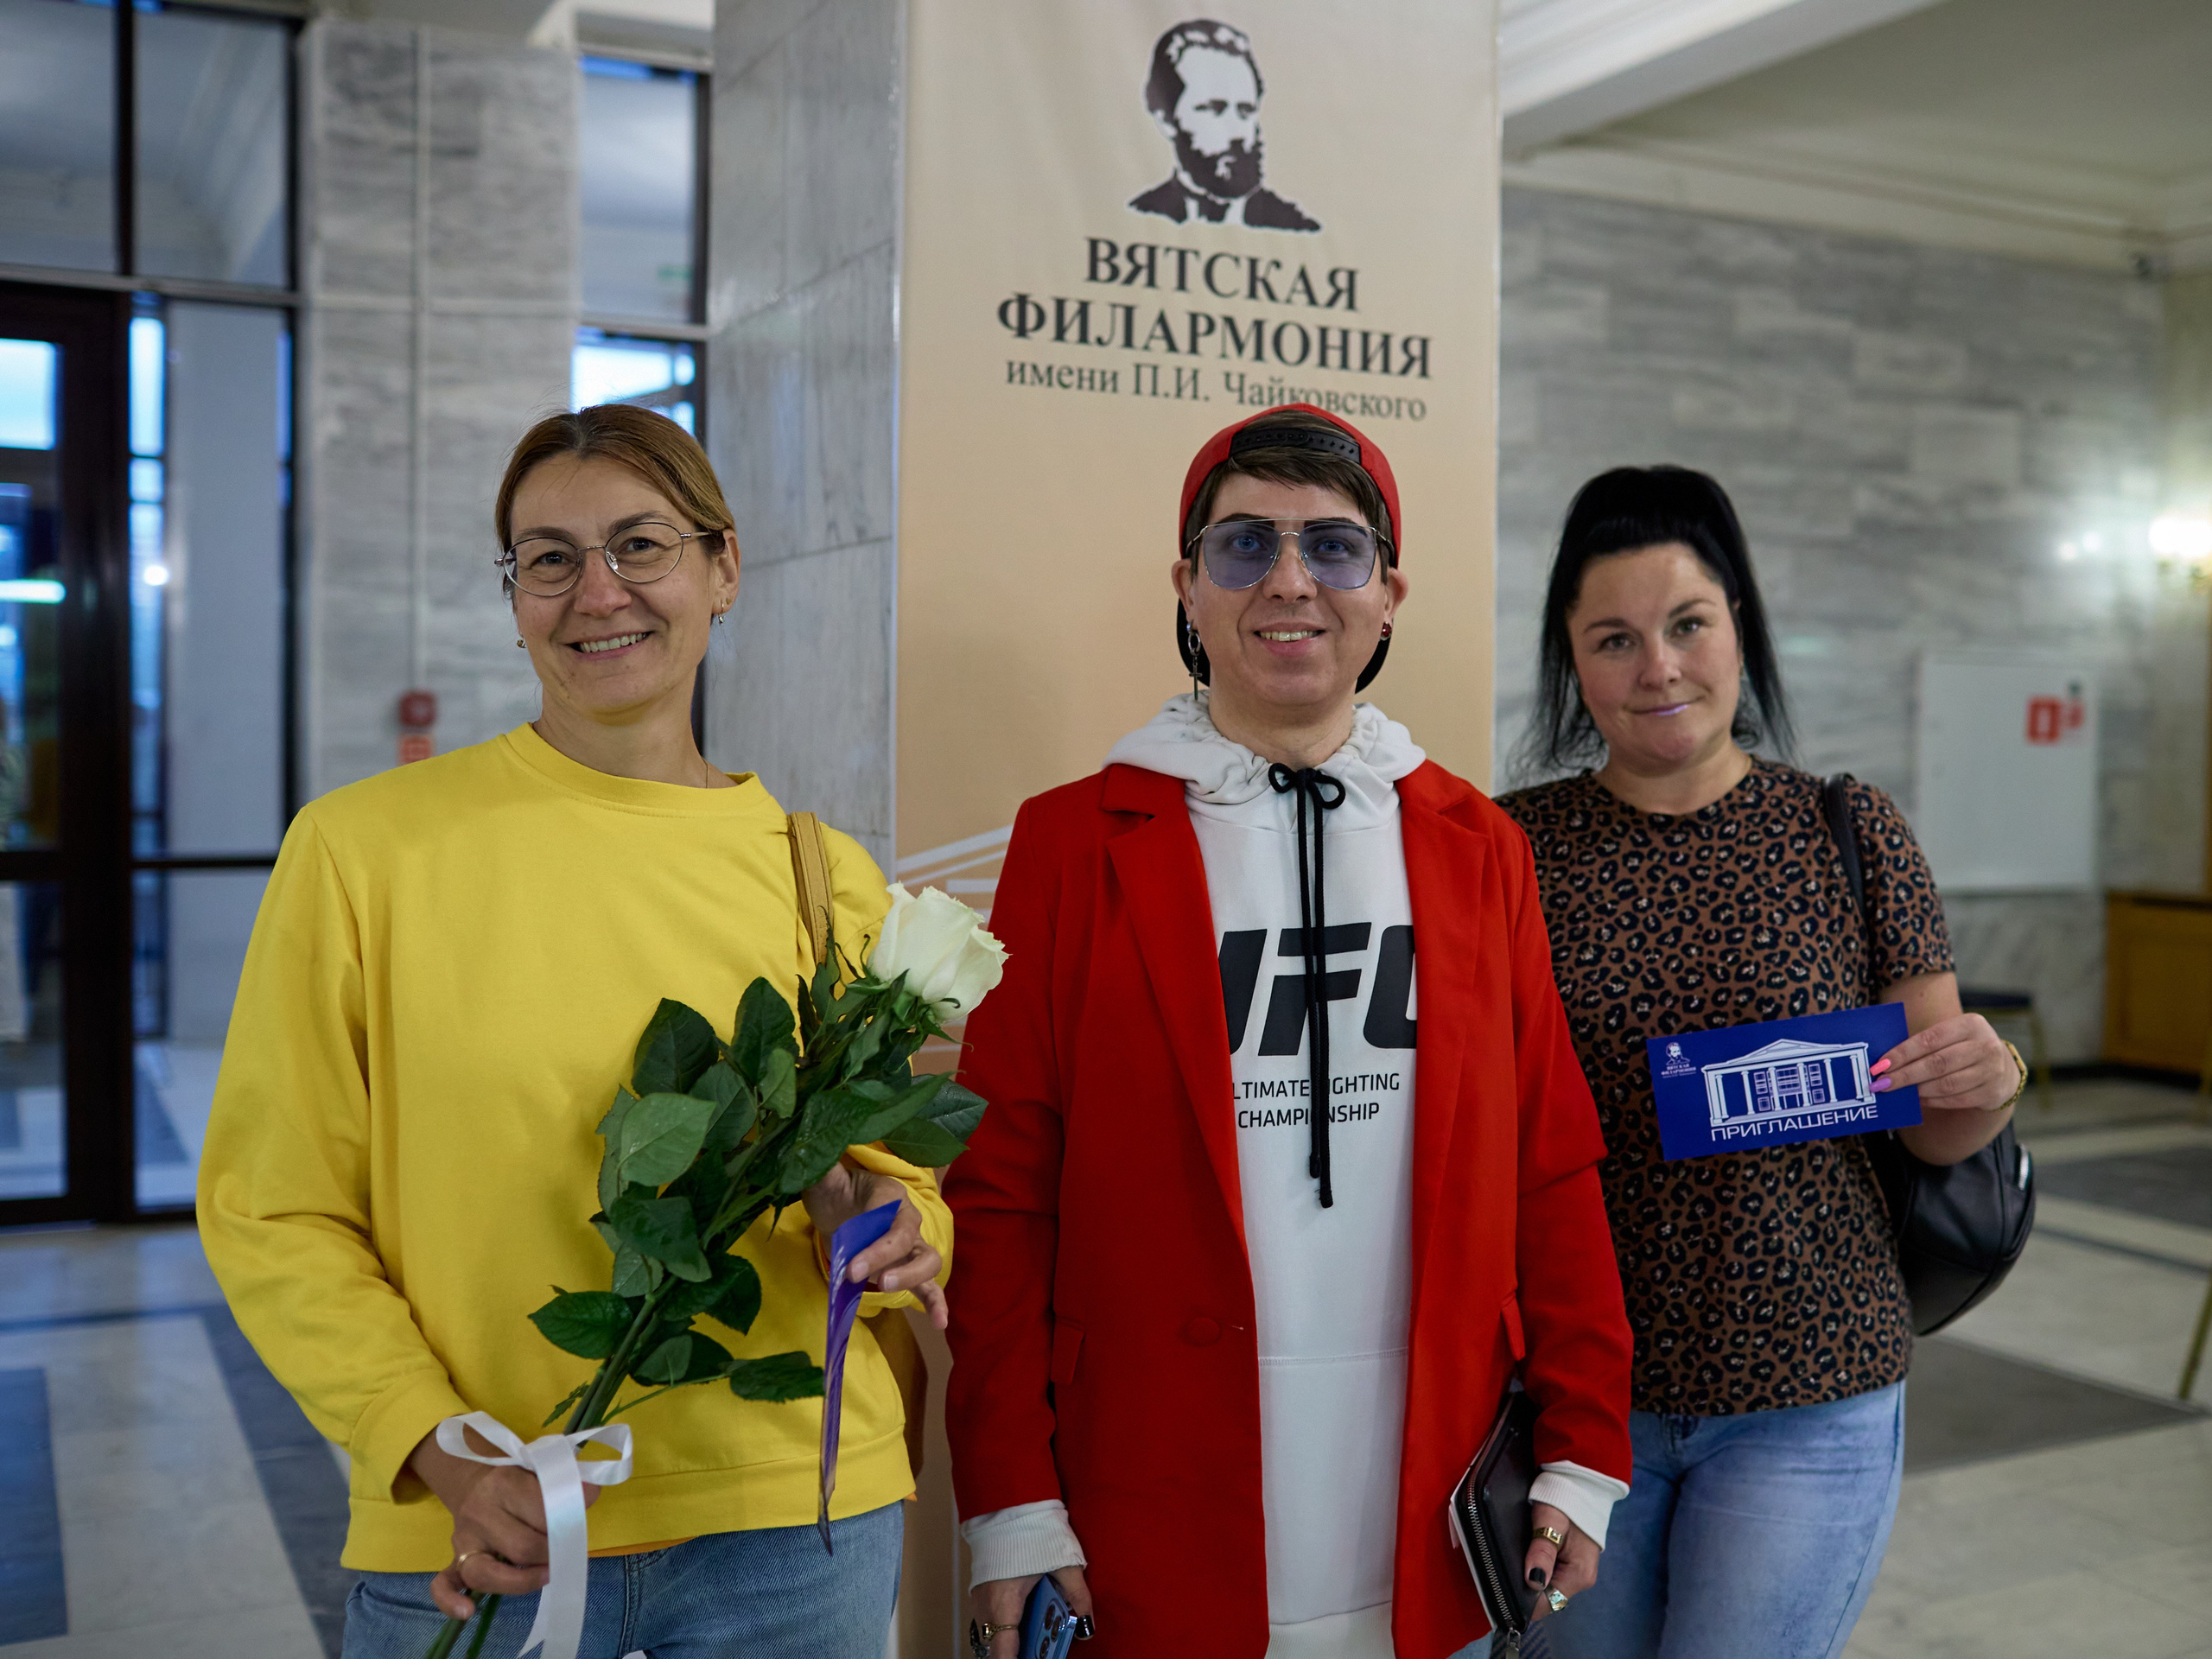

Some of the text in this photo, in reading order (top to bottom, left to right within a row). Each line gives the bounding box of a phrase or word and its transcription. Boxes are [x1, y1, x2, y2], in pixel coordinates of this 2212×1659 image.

[1084, 237, 1360, 311] ВЯТСКАЯ
[997, 292, 1433, 378] ФИЛАРМОНИЯ
[1007, 360, 1427, 421] имени П.И. Чайковского
[1233, 1073, 1400, 1099] LTIMATE GHTING
[1238, 1103, 1380, 1128] CHAMPINSHIP
[1711, 1105, 1878, 1141] ПРИГЛАШЕНИЕ
